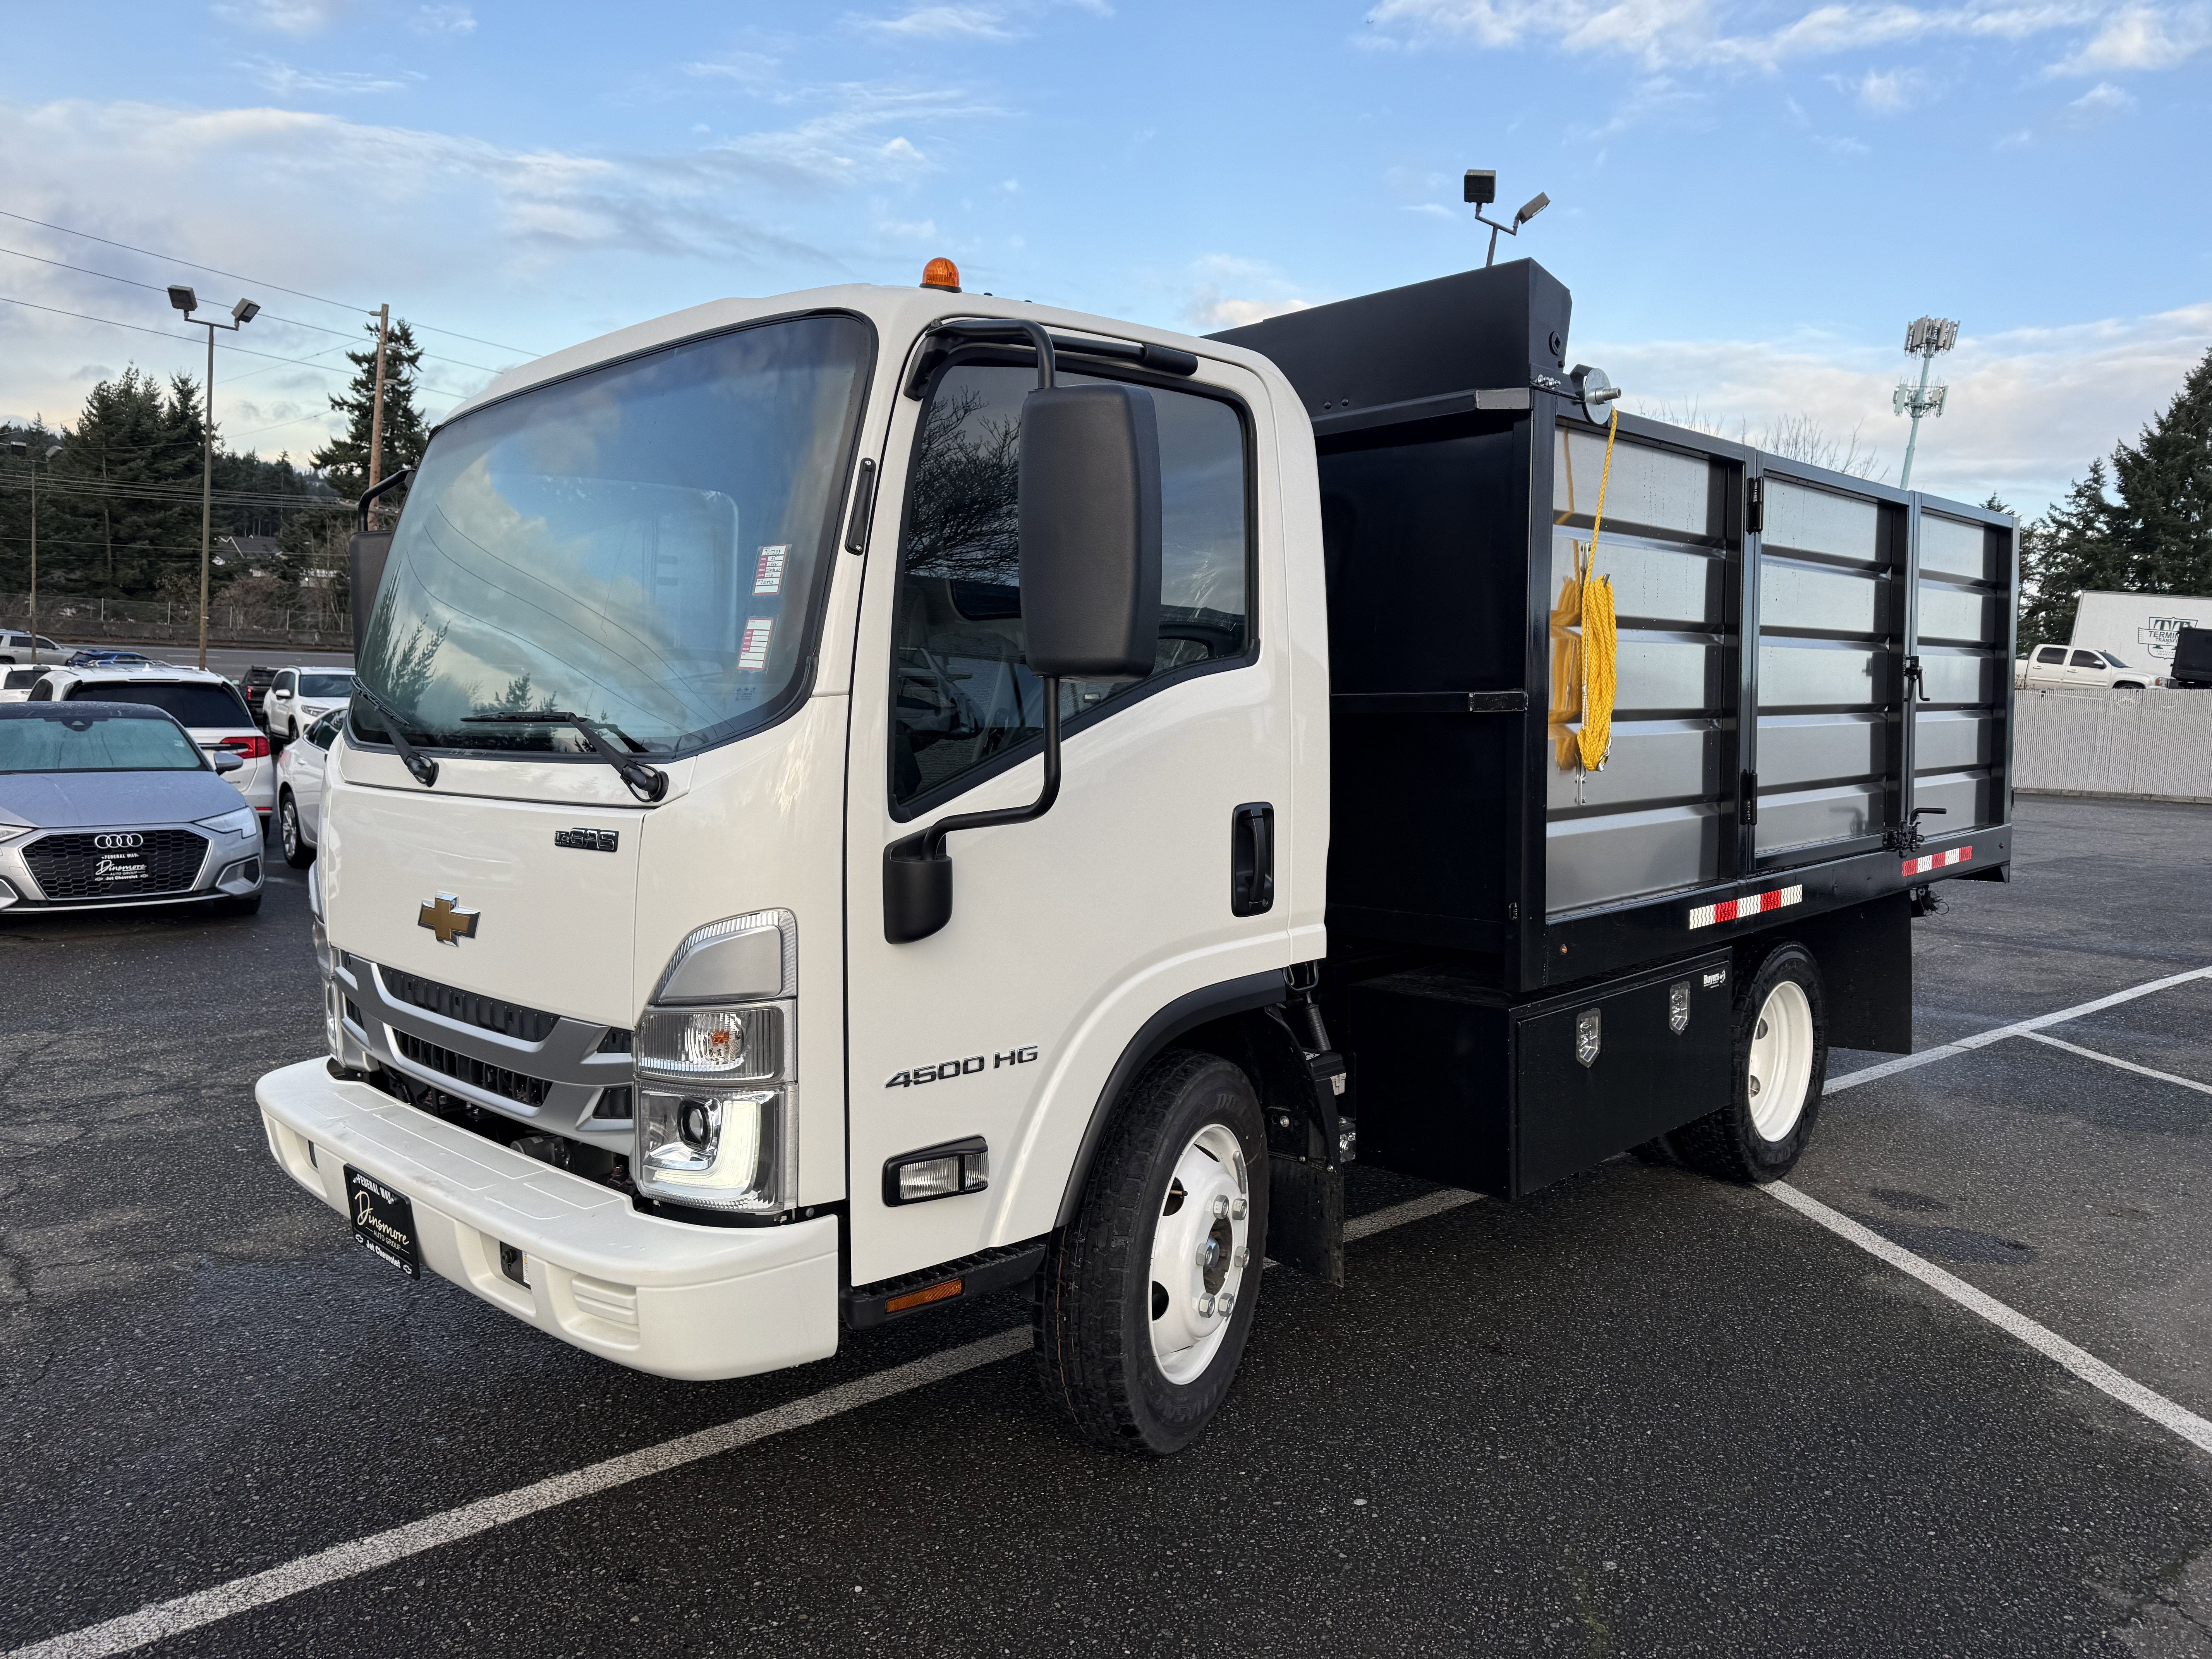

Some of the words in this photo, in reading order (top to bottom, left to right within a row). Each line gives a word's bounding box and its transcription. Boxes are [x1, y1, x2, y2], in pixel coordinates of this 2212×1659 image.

[571, 828, 616, 850] GAS
[95, 859, 147, 875] Dinsmore
[1704, 973, 1720, 985] Buyers
[884, 1055, 984, 1088] 4500
[993, 1044, 1038, 1069] HG
[357, 1173, 380, 1195] FEDERAL
[380, 1187, 391, 1201] WAY
[354, 1190, 410, 1245] Dinsmore
[373, 1230, 385, 1241] AUTO
[385, 1237, 401, 1251] GROUP
[366, 1240, 375, 1252] Jet
[375, 1245, 400, 1269] Chevrolet
